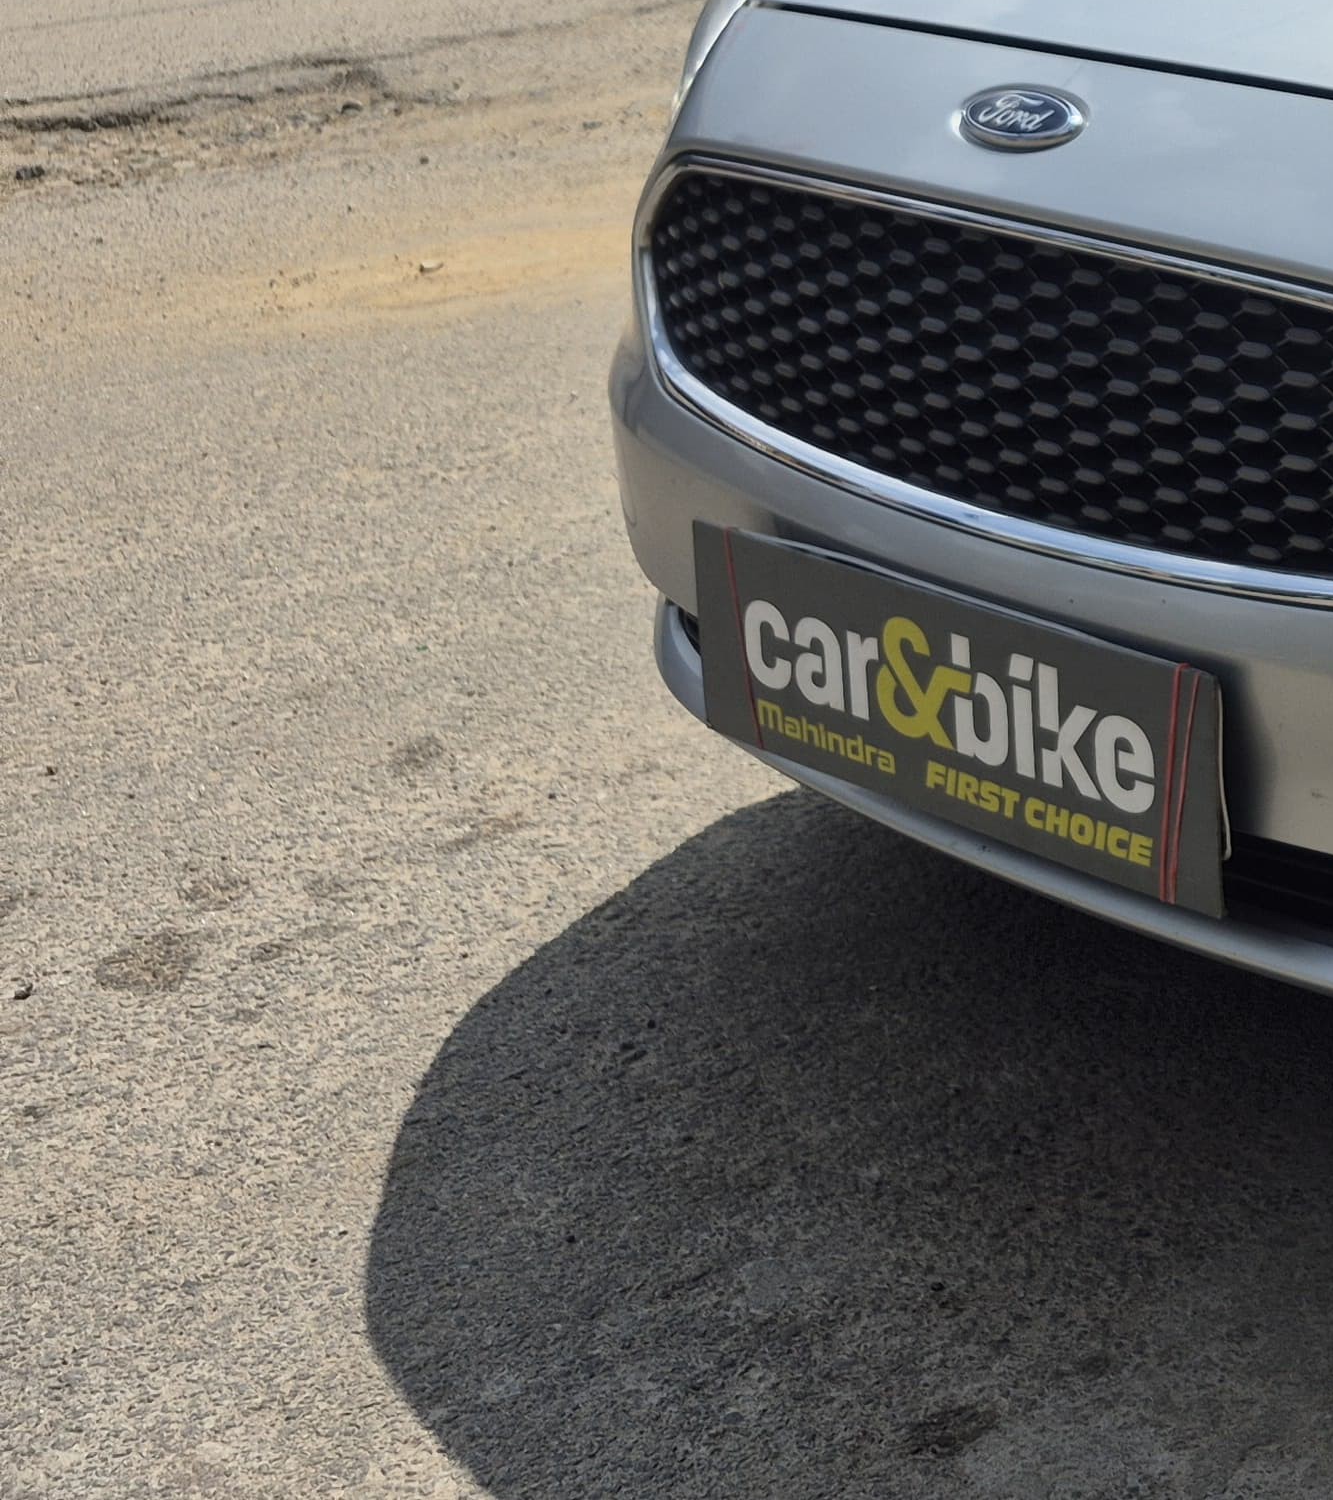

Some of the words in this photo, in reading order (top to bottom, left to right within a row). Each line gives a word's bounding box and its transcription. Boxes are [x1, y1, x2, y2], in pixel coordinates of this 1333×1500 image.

[744, 599, 1156, 814] car&bike
[757, 698, 896, 775] Mahindra
[926, 760, 1022, 819] FIRST
[1024, 798, 1154, 868] CHOICE
